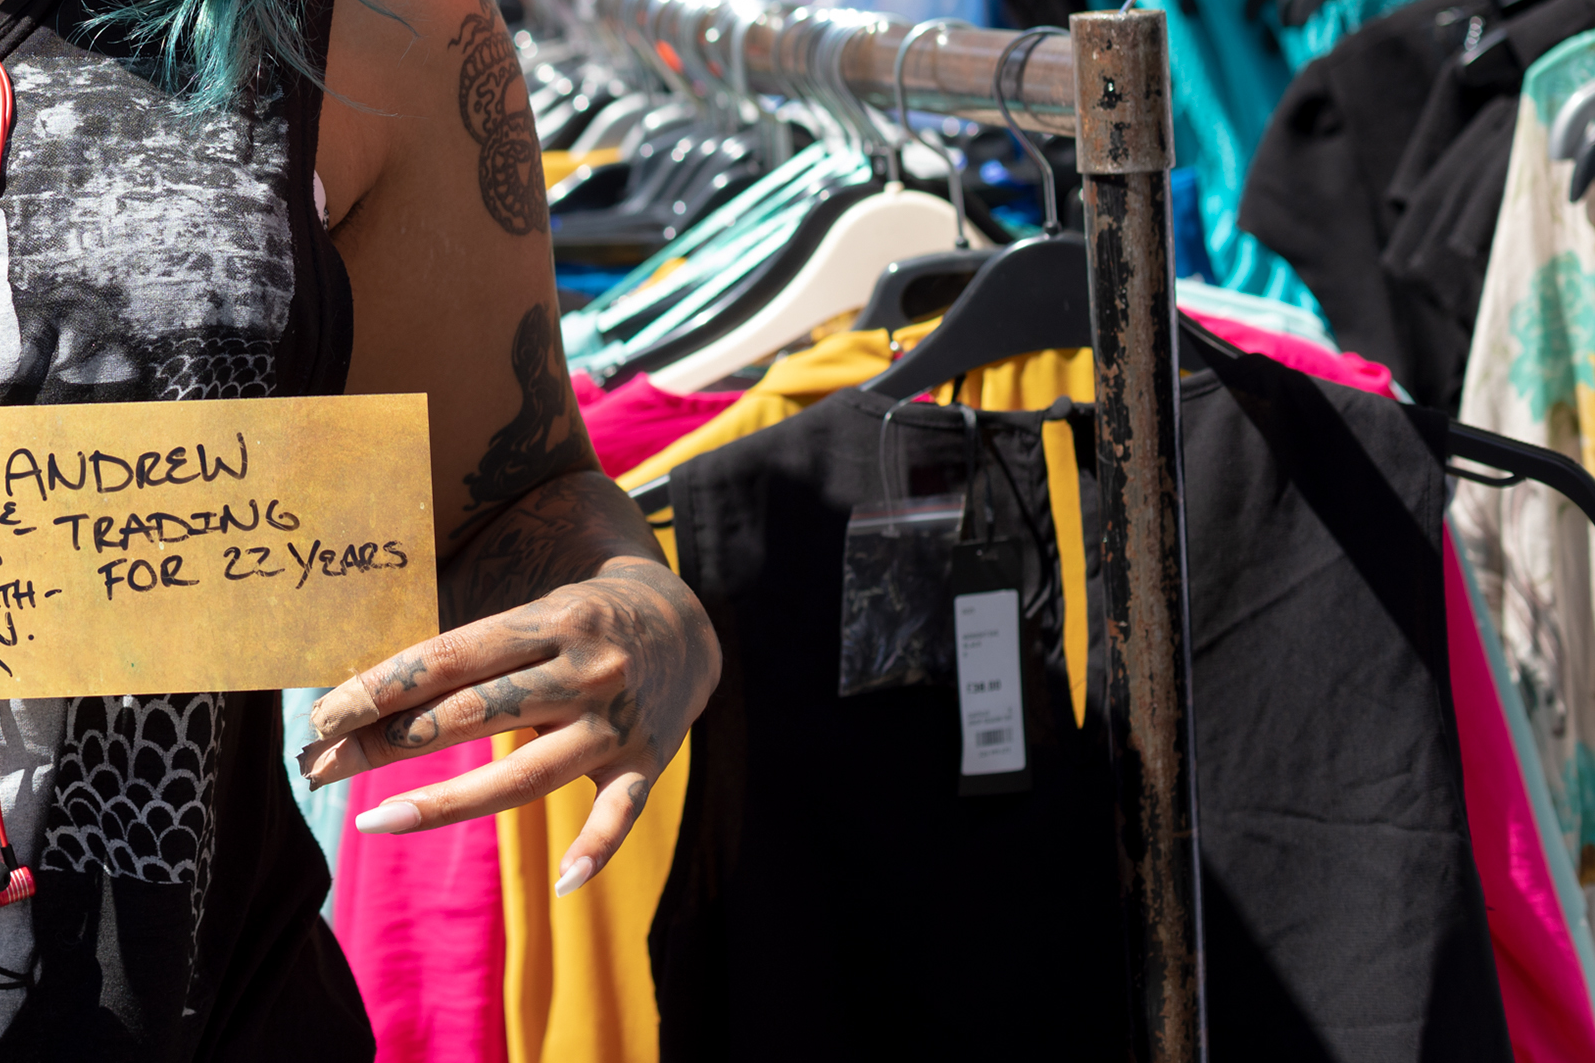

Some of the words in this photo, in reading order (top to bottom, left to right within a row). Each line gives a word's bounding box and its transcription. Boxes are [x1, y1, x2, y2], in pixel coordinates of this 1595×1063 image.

[5, 432, 249, 502] ANDREW
[53, 499, 300, 554] TRADING
[96, 554, 199, 601] FOR
[223, 546, 285, 581] 22
[287, 539, 408, 589] YEARS
